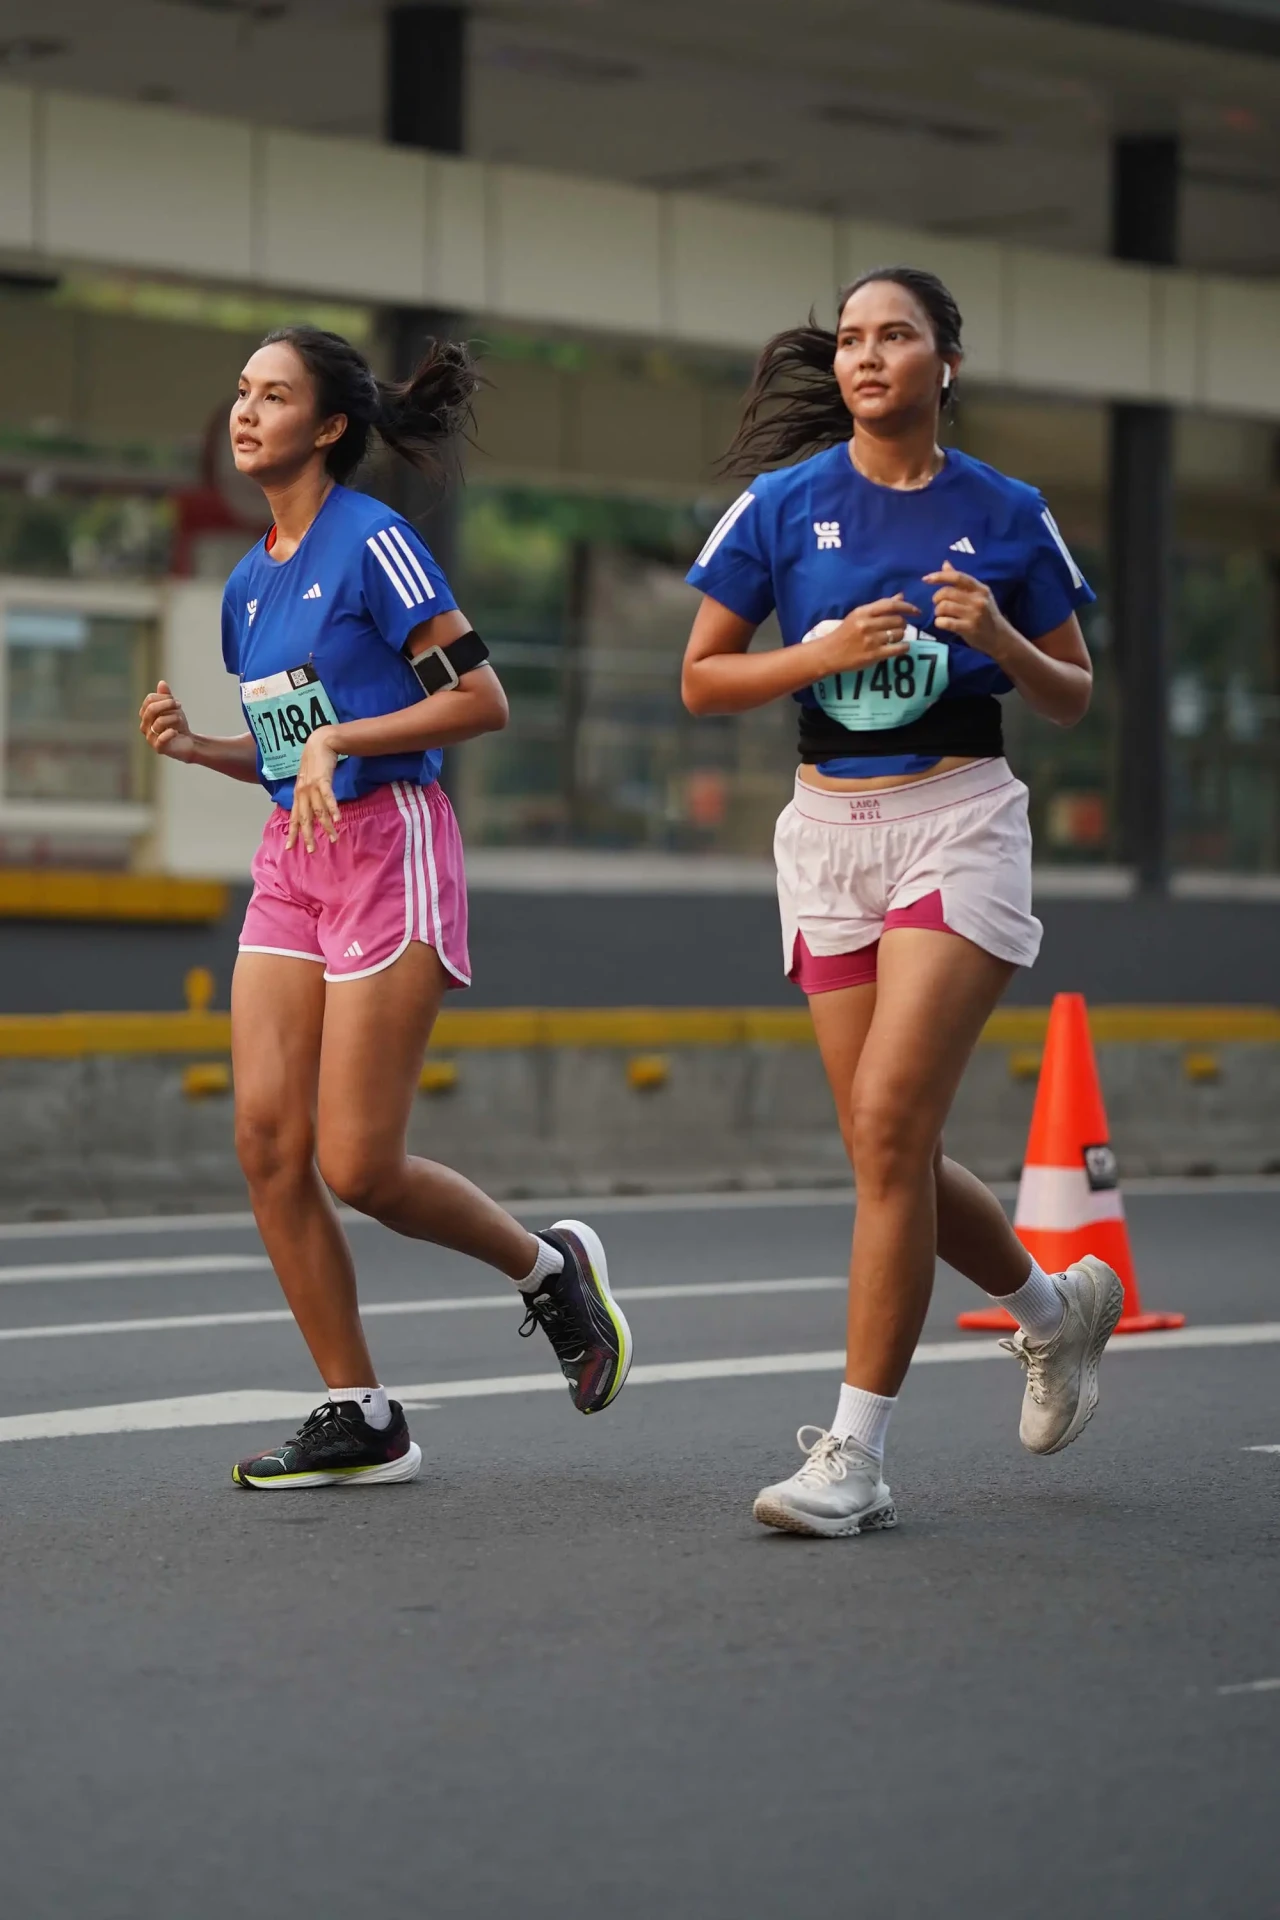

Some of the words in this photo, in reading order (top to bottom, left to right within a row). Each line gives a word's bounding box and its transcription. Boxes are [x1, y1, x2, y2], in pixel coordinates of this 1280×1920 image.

[834, 654, 938, 700] 17487
[258, 695, 332, 753] 17484
[850, 799, 880, 809] LAICA
